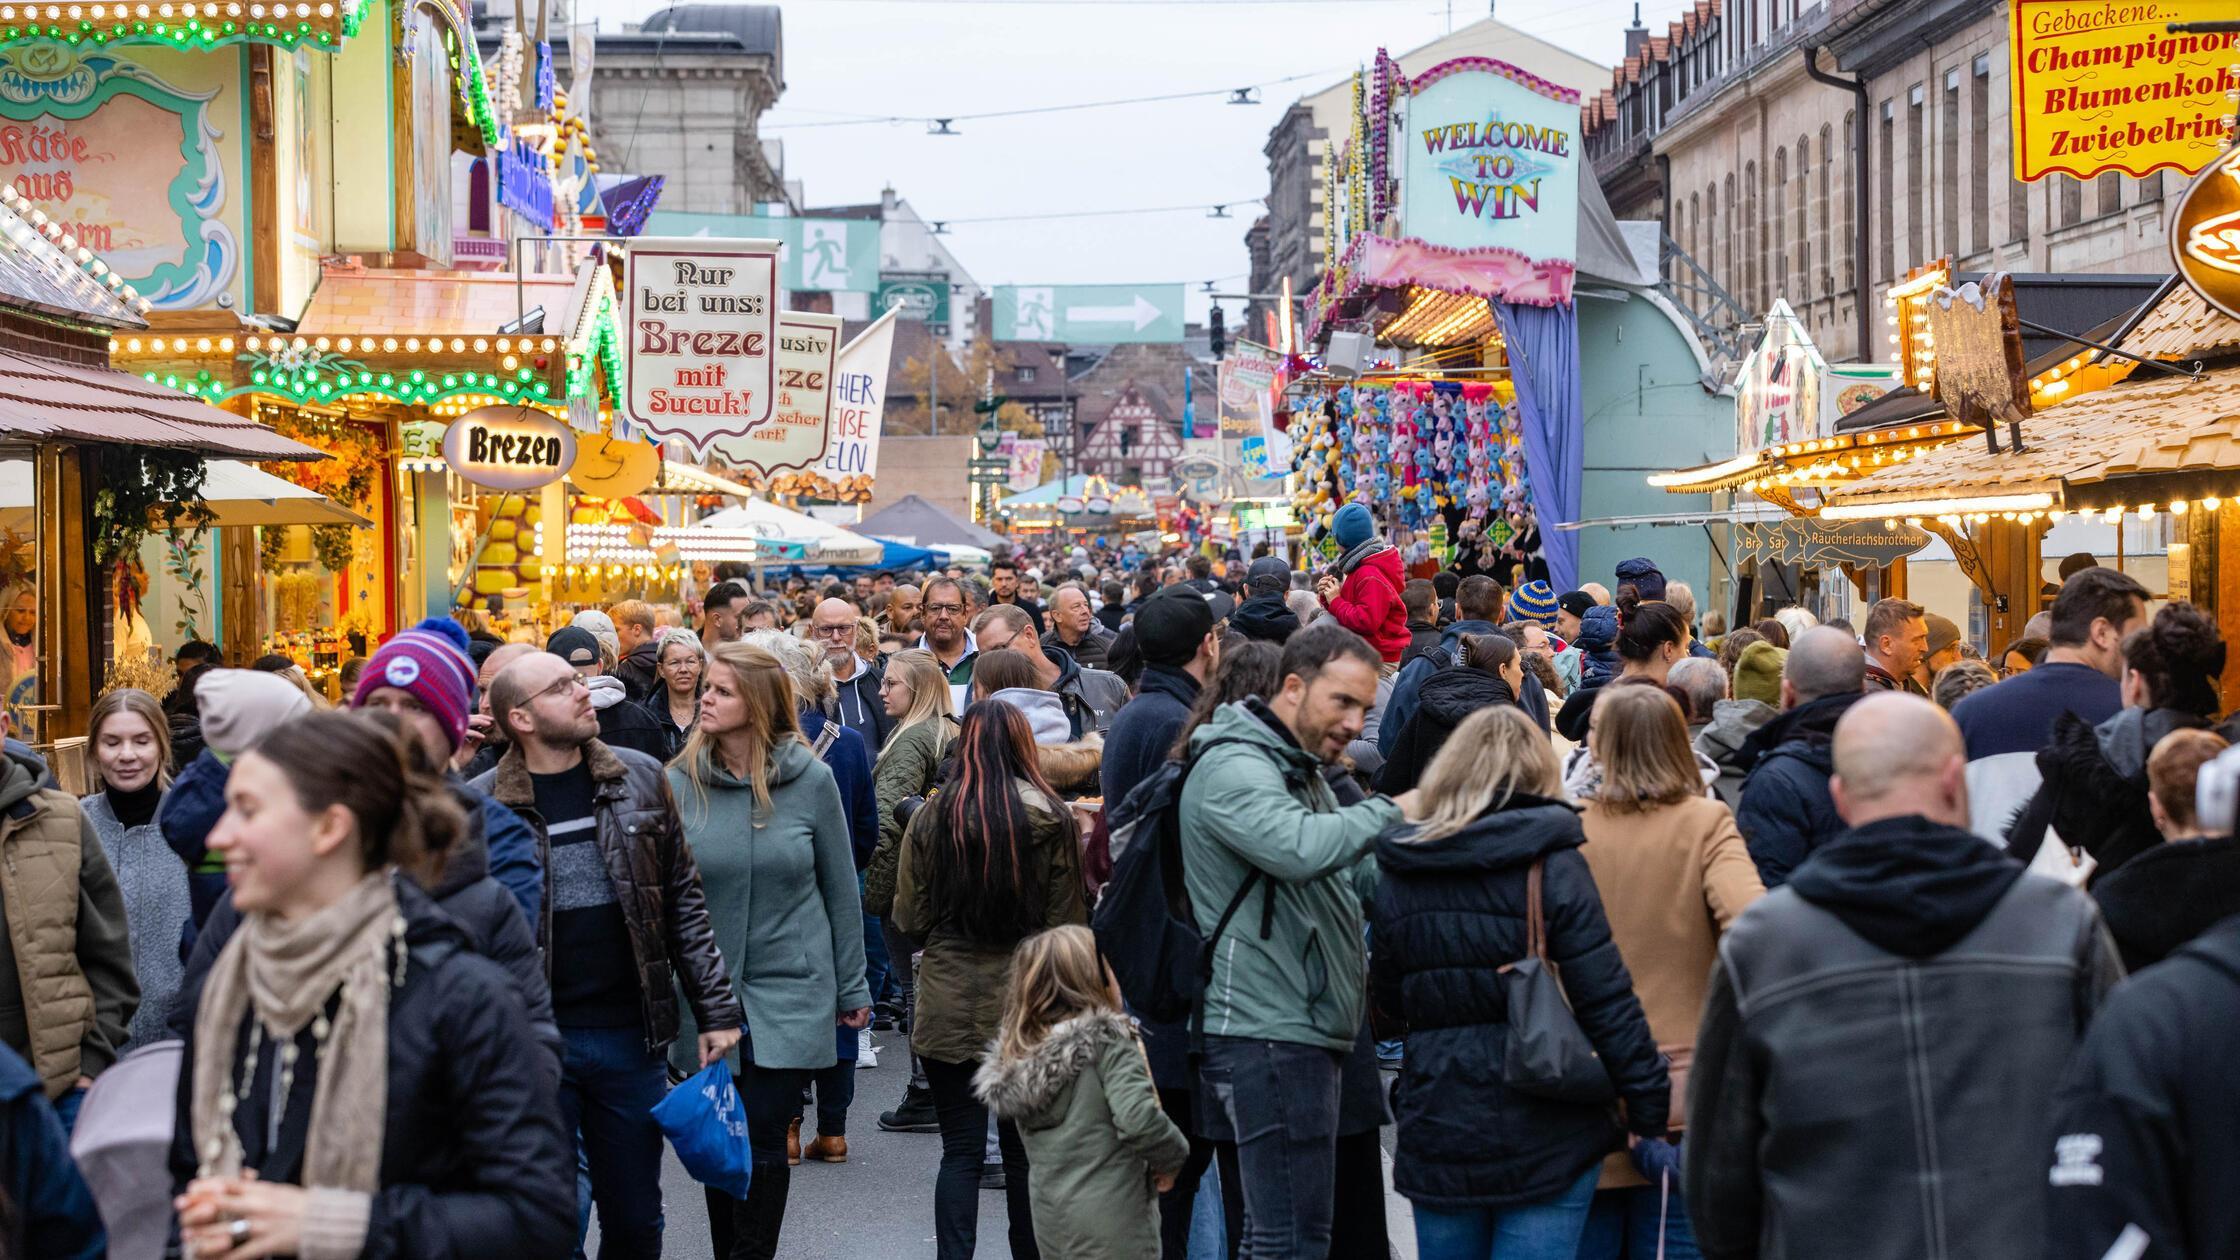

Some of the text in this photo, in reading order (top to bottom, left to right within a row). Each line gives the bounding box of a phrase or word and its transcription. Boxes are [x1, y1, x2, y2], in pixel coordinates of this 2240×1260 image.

[2042, 66, 2240, 115] Blumenkoh
[1422, 121, 1569, 159] WELCOME
[1472, 154, 1514, 179] TO
[13, 170, 74, 202] aus
[1449, 175, 1542, 220] WIN
[674, 261, 734, 286] Nur
[643, 288, 764, 315] bei uns:
[637, 320, 765, 356] Breze
[780, 336, 827, 353] usiv
[675, 364, 727, 388] mit
[778, 369, 823, 391] ze
[649, 389, 752, 416] Sucuk!
[774, 411, 820, 426] scher
[468, 426, 562, 466] Brezen
[1745, 536, 1762, 549] Bra
[1811, 531, 1923, 547] Räucherlachsbrötchen
